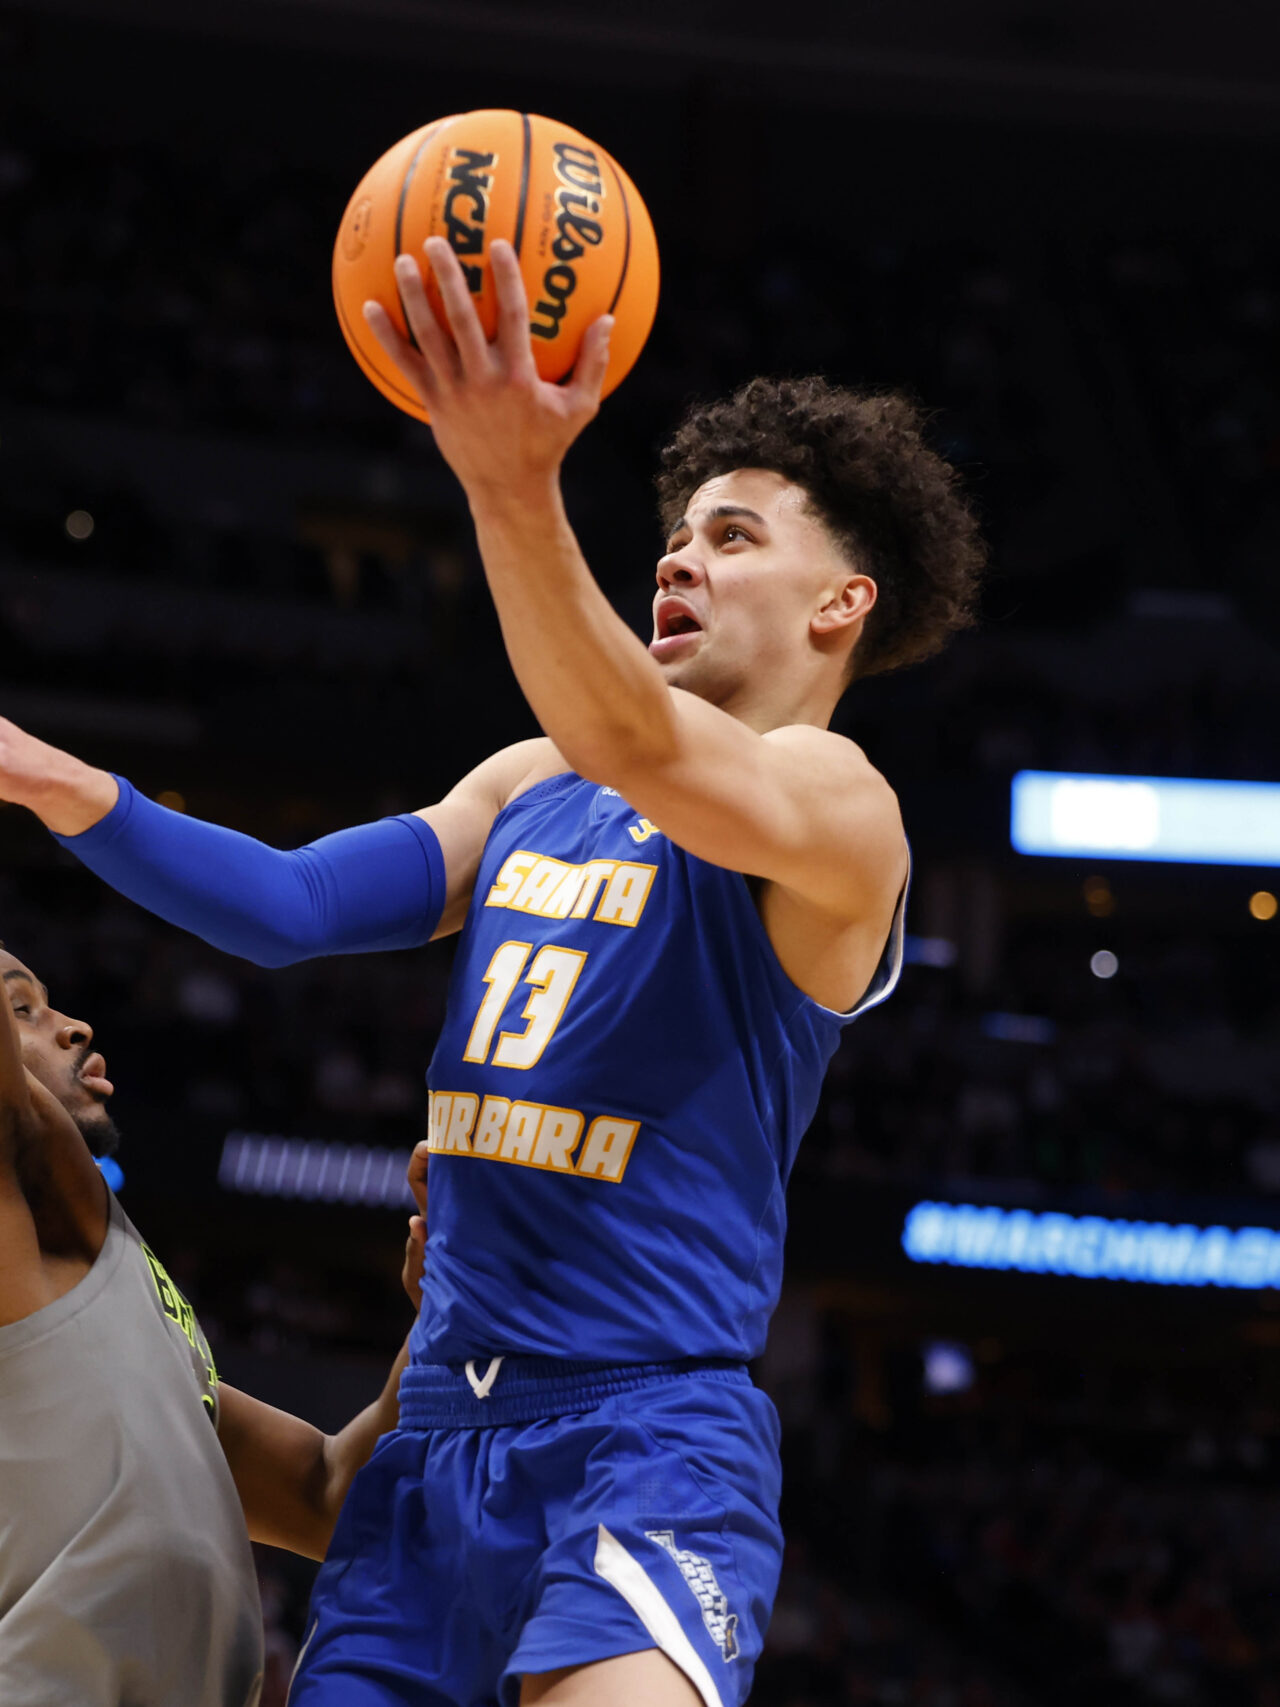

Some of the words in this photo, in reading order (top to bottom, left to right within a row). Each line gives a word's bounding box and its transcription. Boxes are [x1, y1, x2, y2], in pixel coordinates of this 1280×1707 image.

[530, 141, 606, 341] Wilson
[485, 850, 658, 927] SANTA
[462, 940, 588, 1070] 13
[427, 1089, 641, 1184] ARBARA
